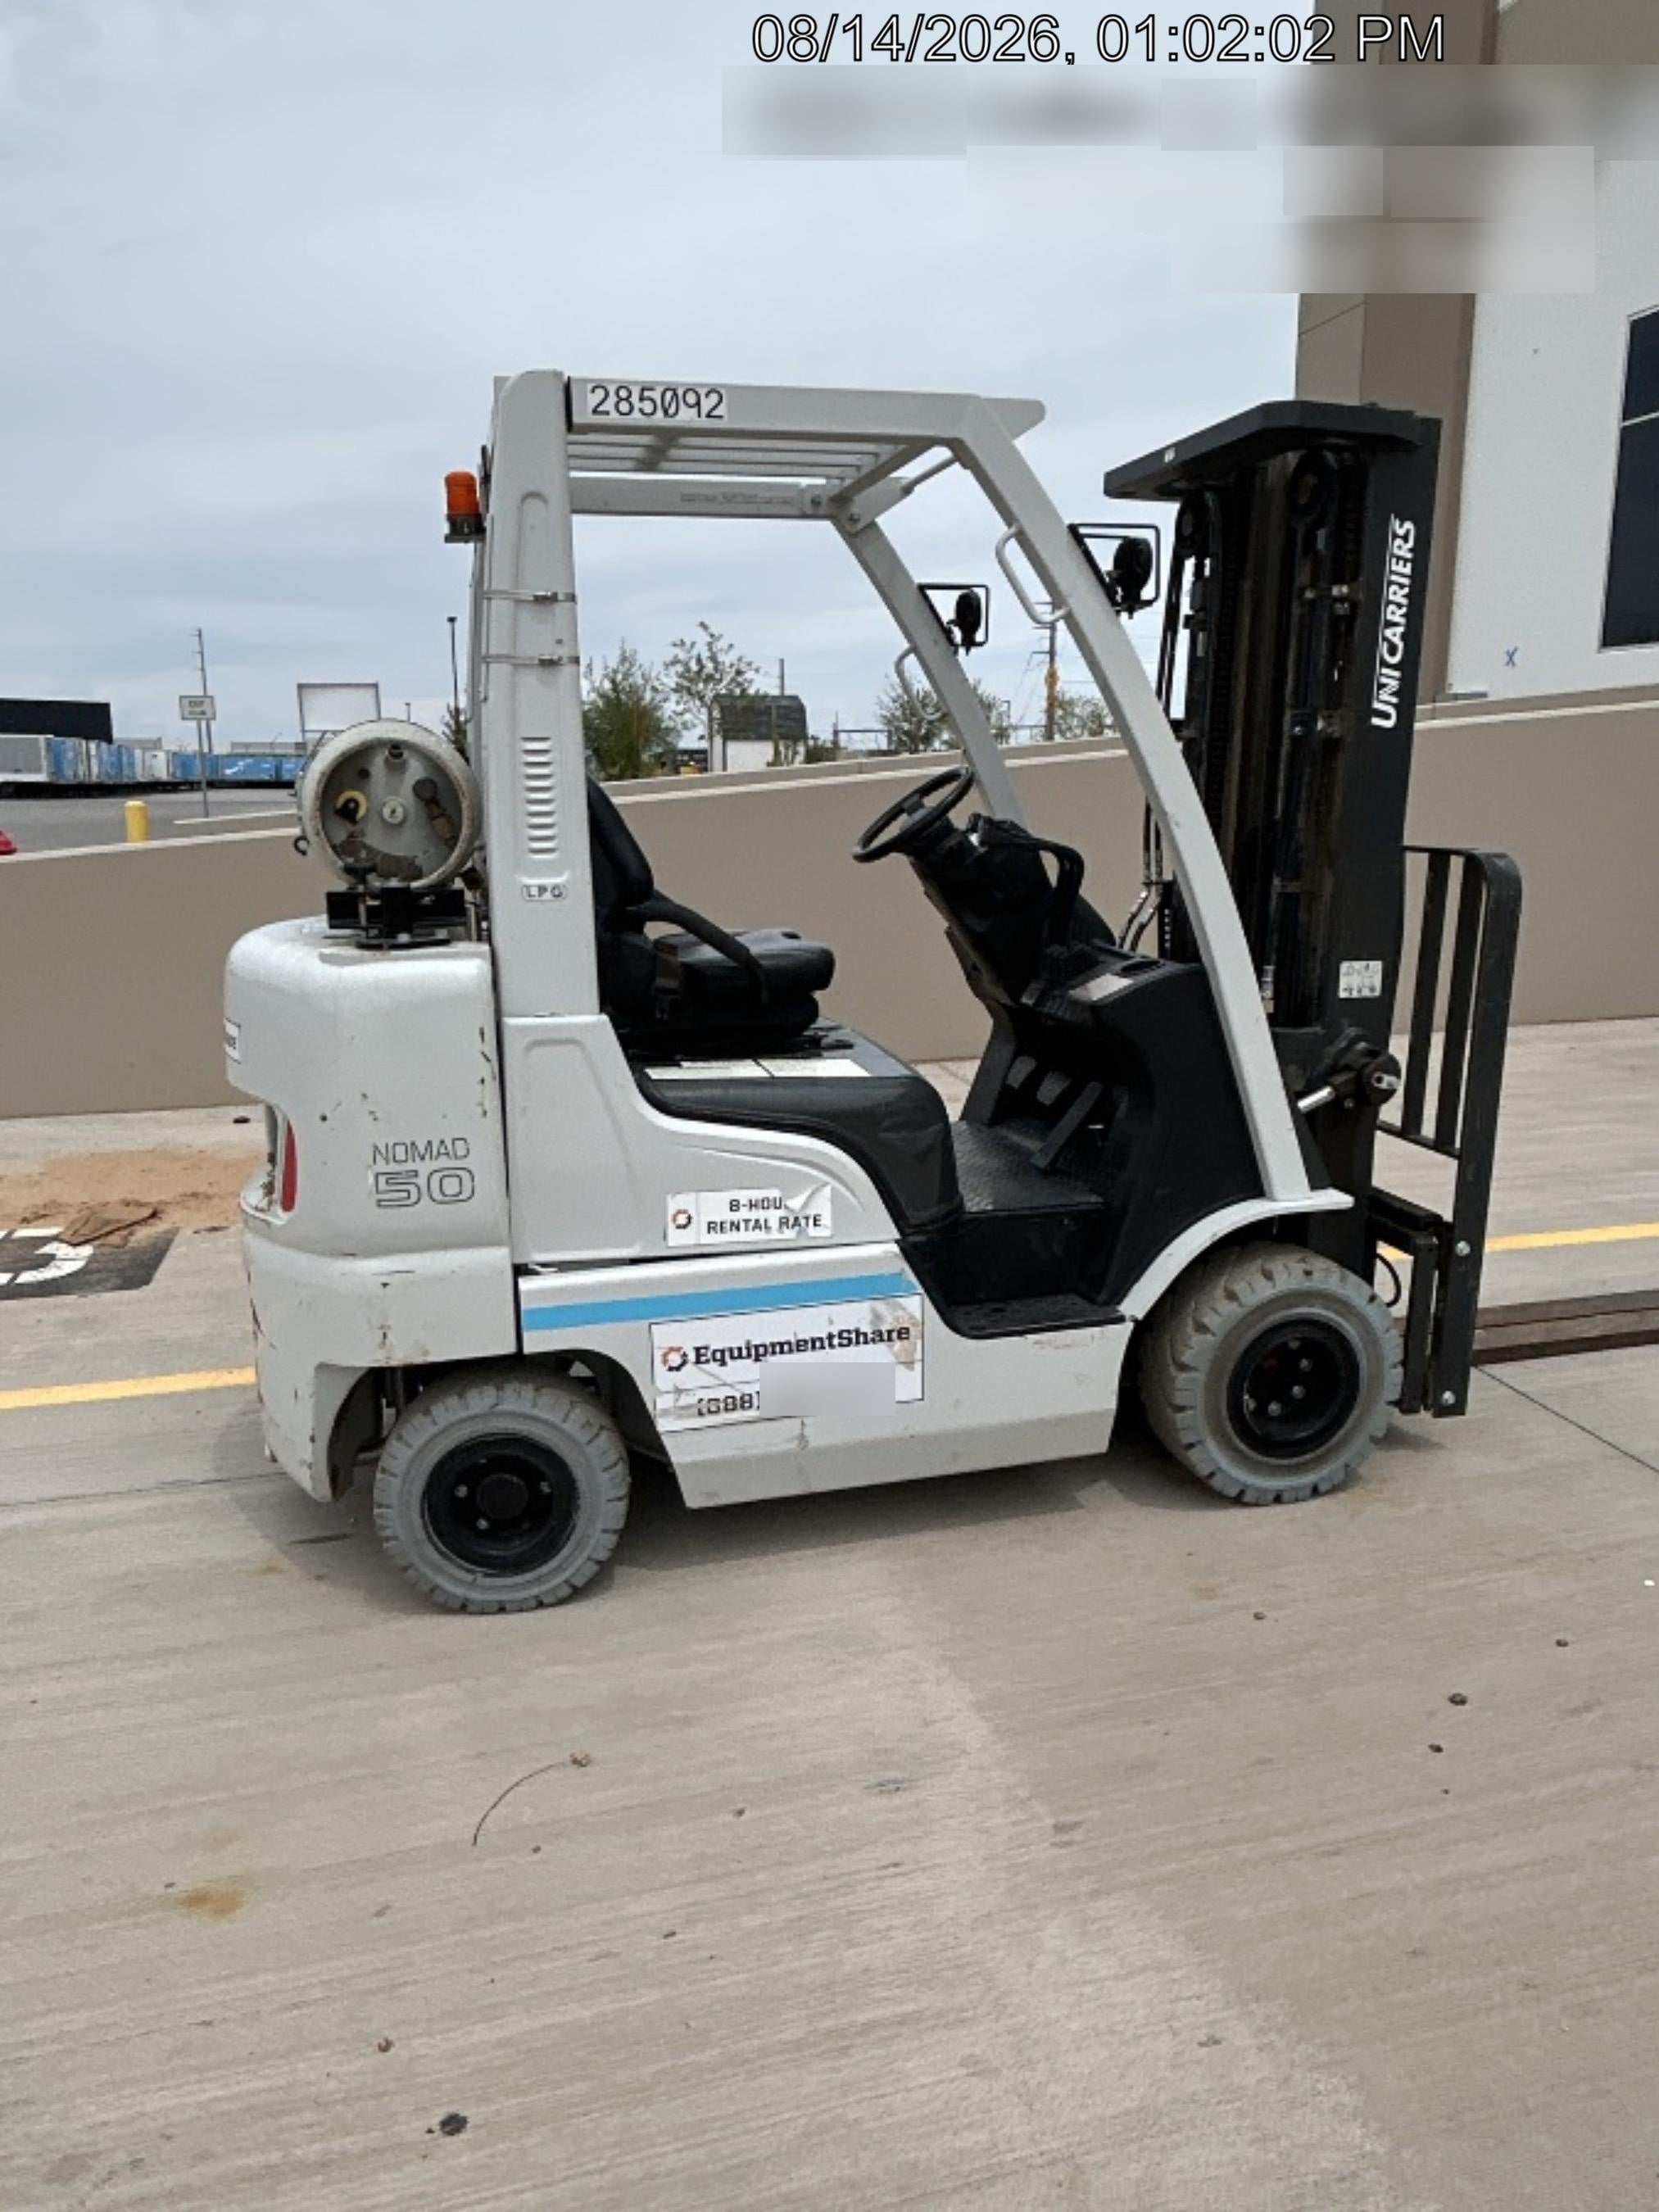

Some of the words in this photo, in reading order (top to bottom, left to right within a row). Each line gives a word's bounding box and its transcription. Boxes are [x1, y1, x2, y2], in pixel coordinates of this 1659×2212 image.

[590, 384, 724, 419] 285092
[1371, 514, 1416, 728] UNICARRIERS
[525, 884, 564, 898] LPG
[373, 1137, 470, 1165] NOMAD
[374, 1167, 475, 1208] 50
[729, 1196, 787, 1213] 8-HOU
[707, 1218, 772, 1235] RENTAL
[778, 1213, 823, 1231] RATE
[693, 1326, 911, 1367] EquipmentShare
